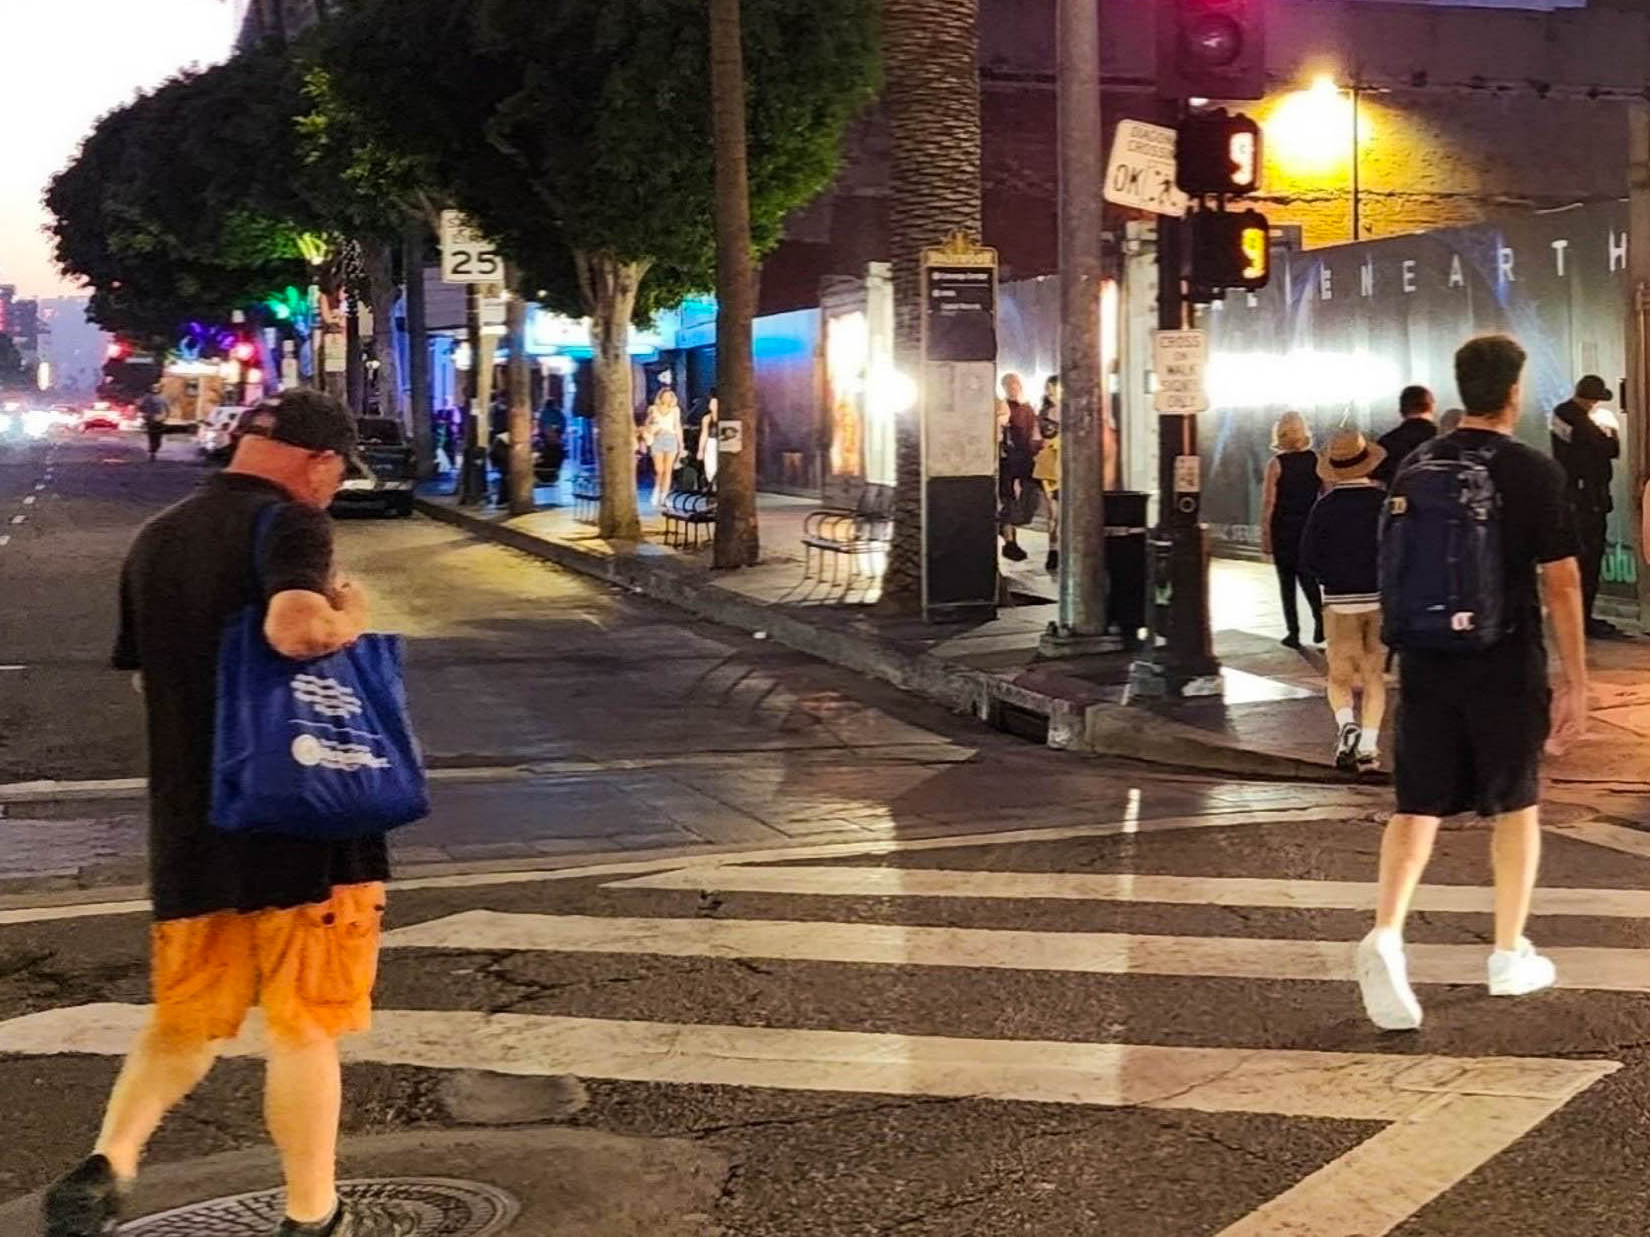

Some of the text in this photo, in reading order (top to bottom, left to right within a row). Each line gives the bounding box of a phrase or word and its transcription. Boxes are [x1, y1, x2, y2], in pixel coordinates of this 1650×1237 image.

[1113, 164, 1144, 196] OK
[451, 250, 498, 274] 25
[1403, 230, 1628, 293] EARTH
[1602, 543, 1637, 582] ulu
